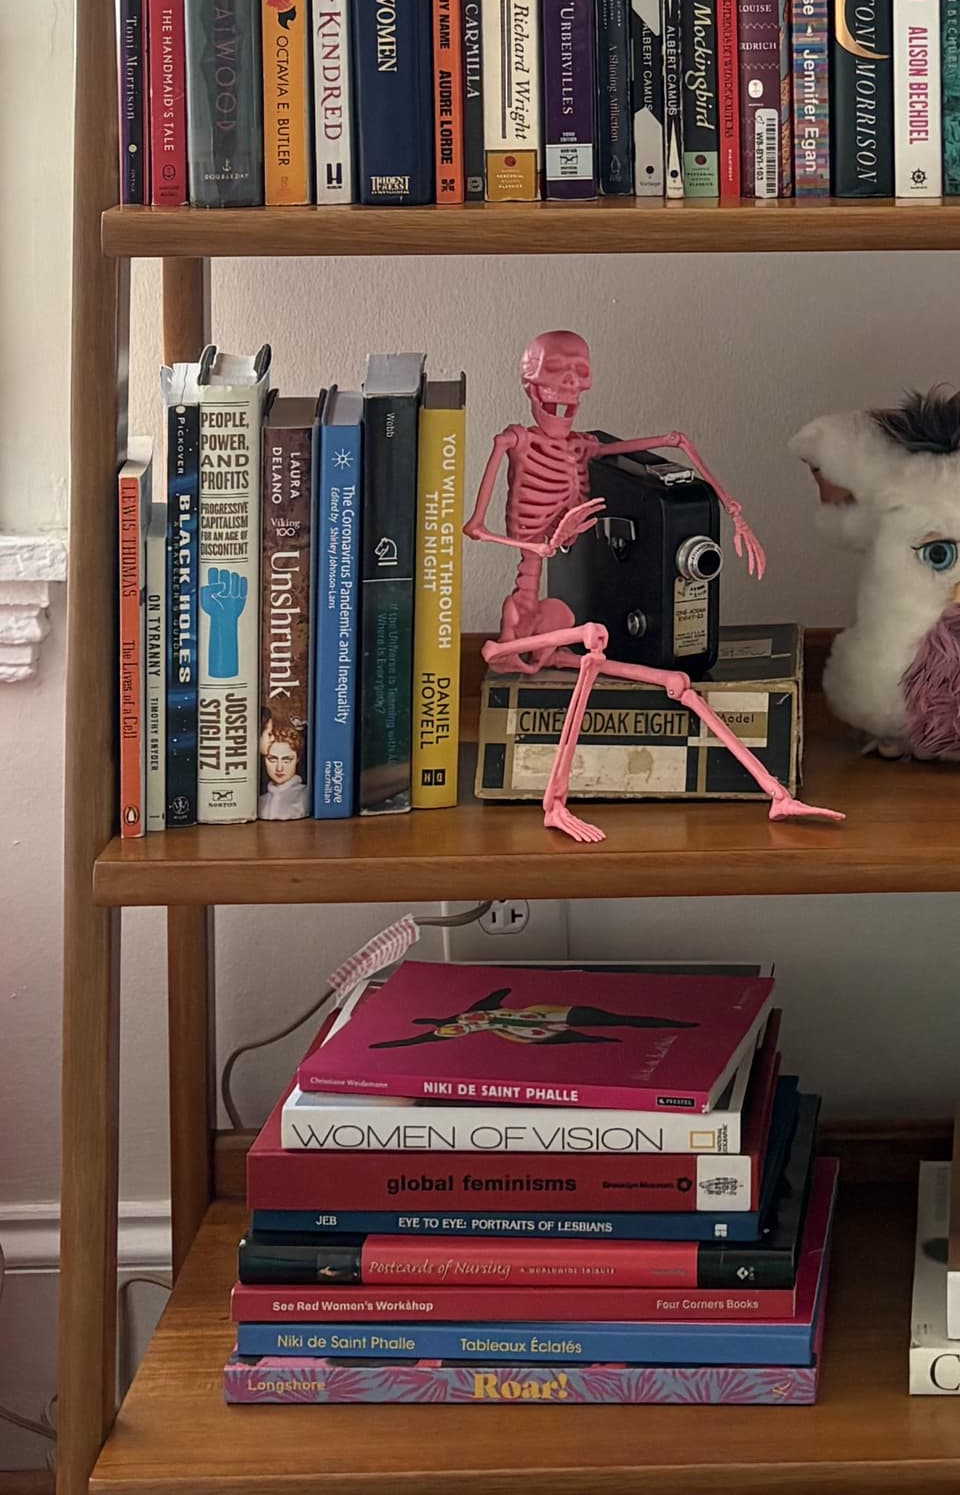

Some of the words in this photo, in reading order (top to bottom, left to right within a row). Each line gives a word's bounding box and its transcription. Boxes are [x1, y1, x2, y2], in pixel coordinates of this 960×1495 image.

[162, 9, 172, 28] THE
[513, 4, 529, 73] Richard
[908, 27, 928, 77] ALISON
[163, 32, 174, 119] HANDMAID'S
[319, 9, 342, 141] KINDRED
[510, 78, 530, 140] Wright
[909, 82, 928, 145] BECHDEL
[164, 123, 174, 152] TALE
[201, 412, 249, 428] PEOPLE,
[201, 434, 249, 452] POWER,
[201, 455, 249, 468] AND
[201, 471, 249, 490] PROFITS
[269, 550, 299, 700] Unshrunk
[200, 699, 221, 770] STIGLITZ
[225, 693, 247, 758] JOSEPH
[424, 1082, 452, 1094] NIKI
[458, 1084, 475, 1096] DE
[481, 1085, 521, 1099] SAINT
[526, 1087, 579, 1102] PHALLE
[292, 1124, 456, 1149] WOMEN
[470, 1126, 526, 1150] OF
[532, 1126, 663, 1152] VISION
[387, 1176, 453, 1195] global
[463, 1176, 576, 1192] feminisms
[460, 1338, 525, 1353] Tableaux
[530, 1337, 582, 1354] Éclatés
[472, 1373, 568, 1400] Roar!
